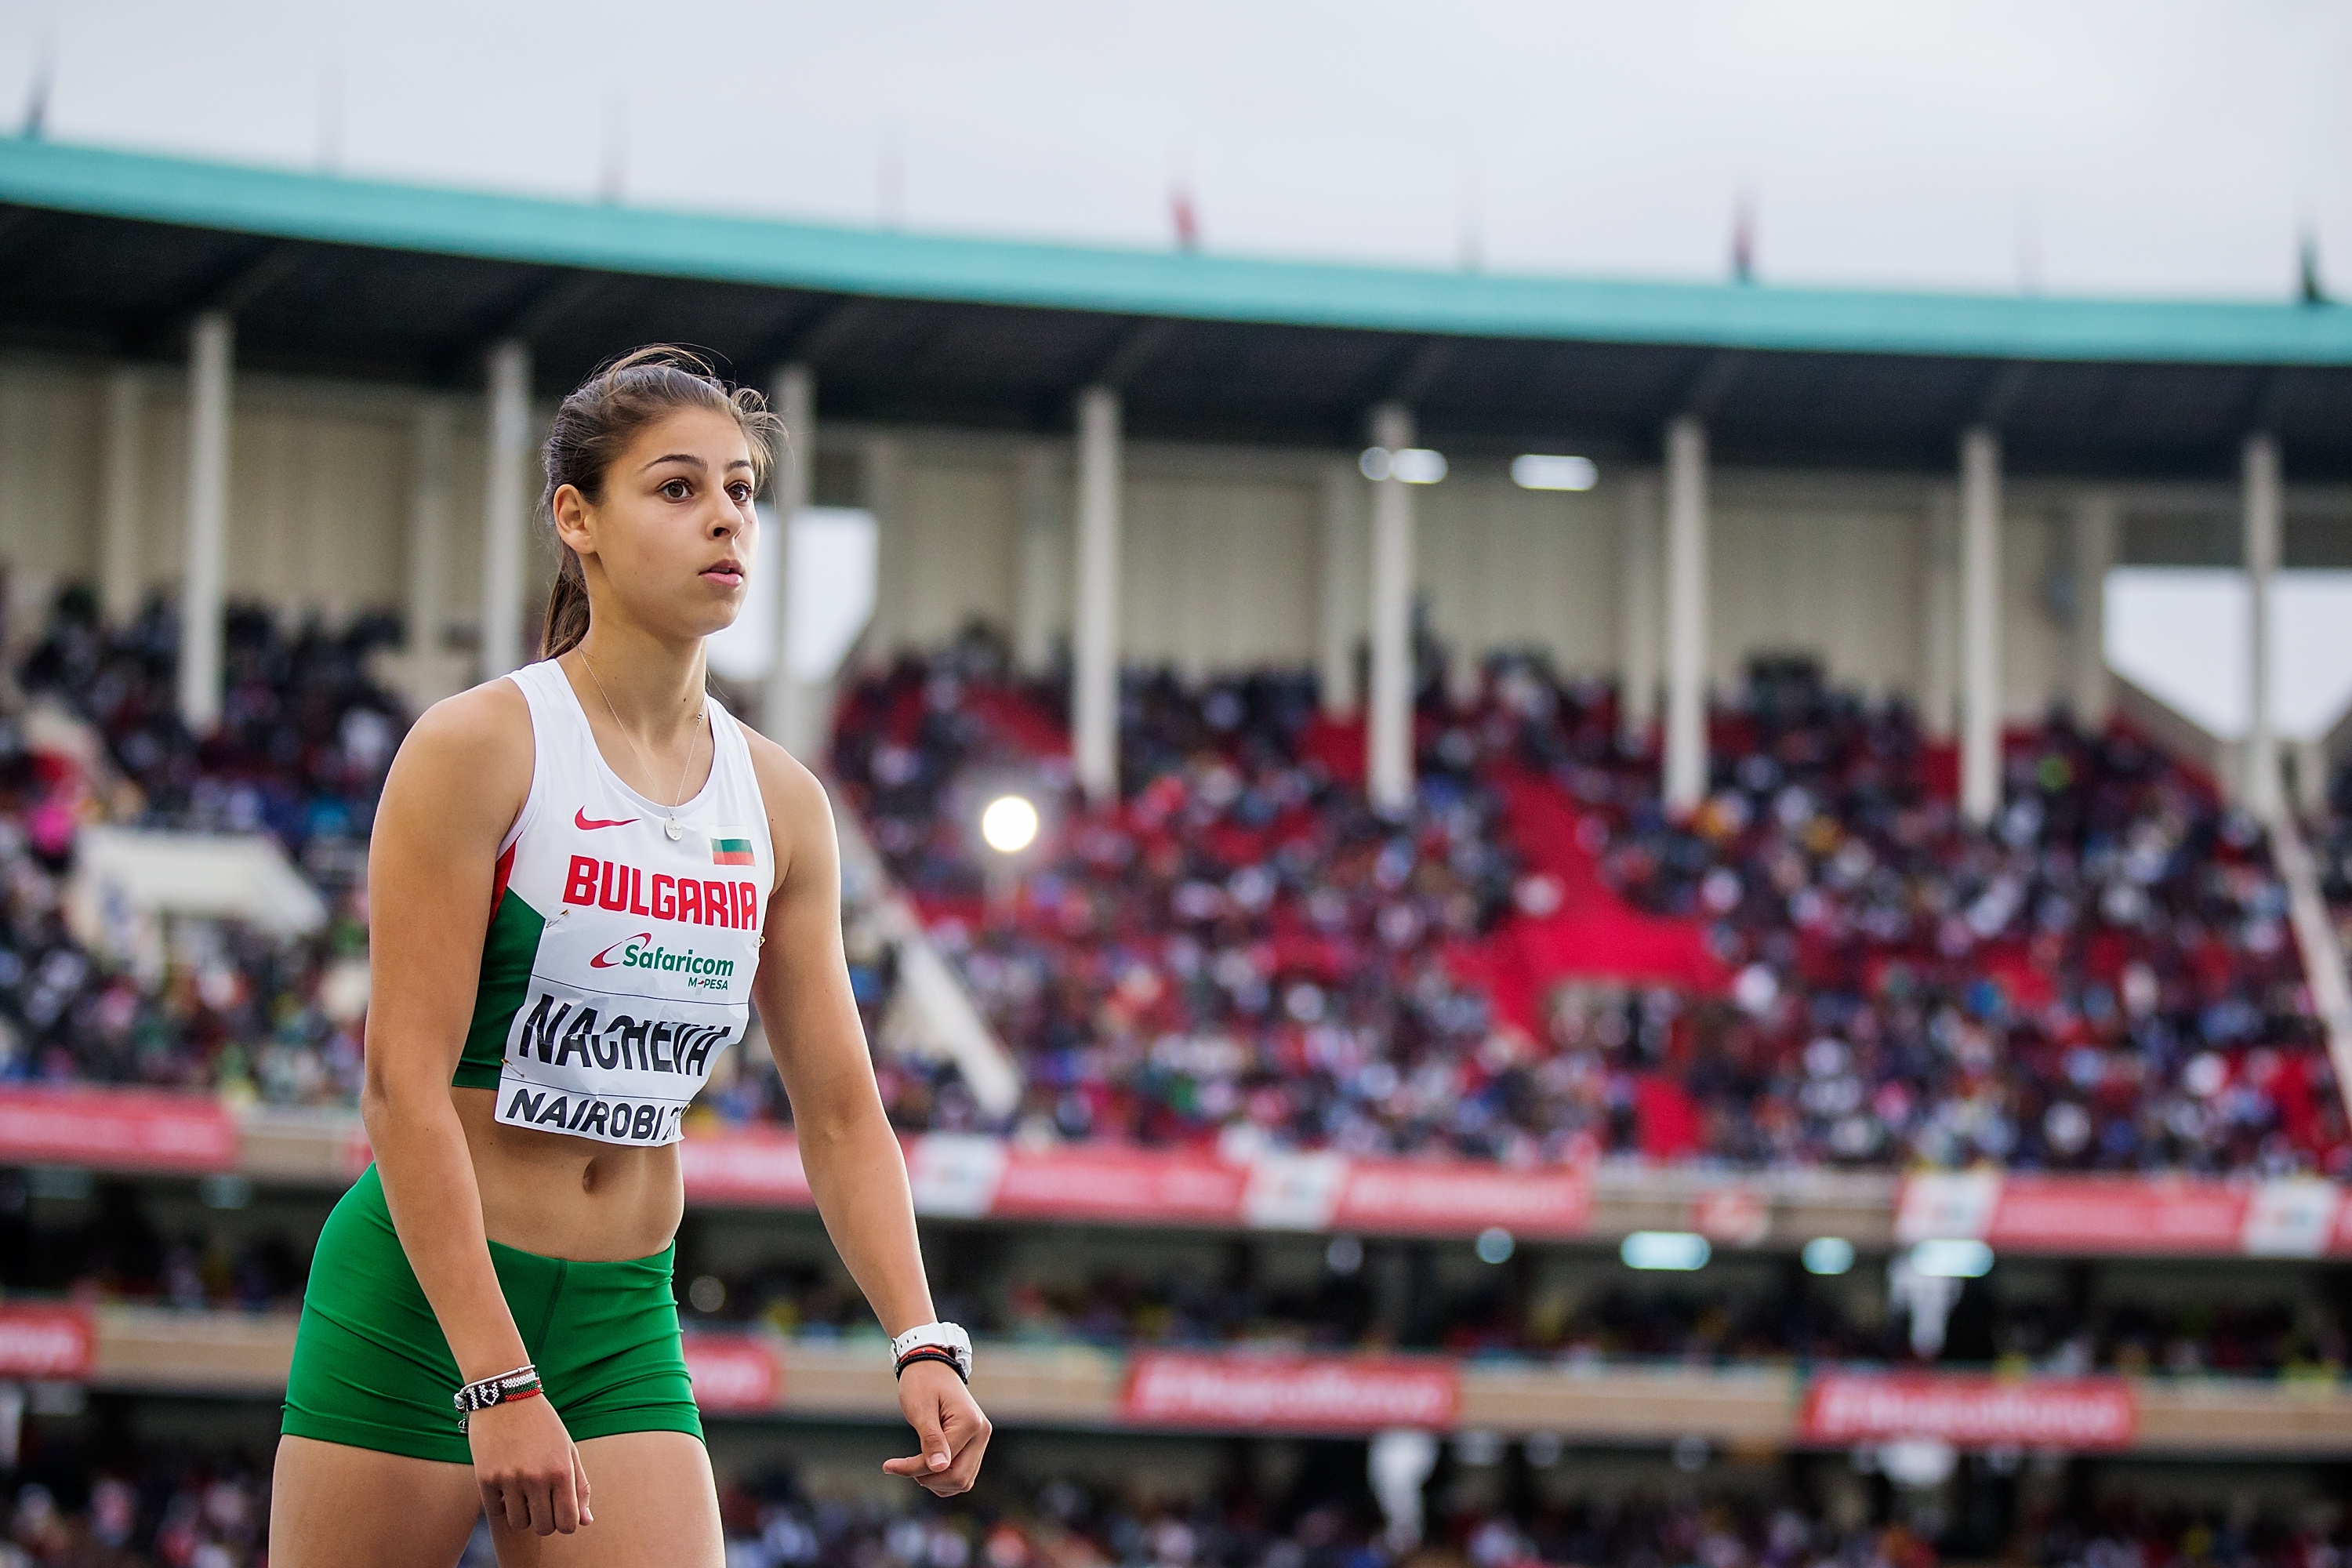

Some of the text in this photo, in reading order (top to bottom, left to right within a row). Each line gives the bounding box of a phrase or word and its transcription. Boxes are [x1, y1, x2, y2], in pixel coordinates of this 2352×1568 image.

[562, 855, 757, 931] BULGARIA
[622, 944, 734, 977] Safaricom
[506, 1088, 665, 1141] NAIROBI
